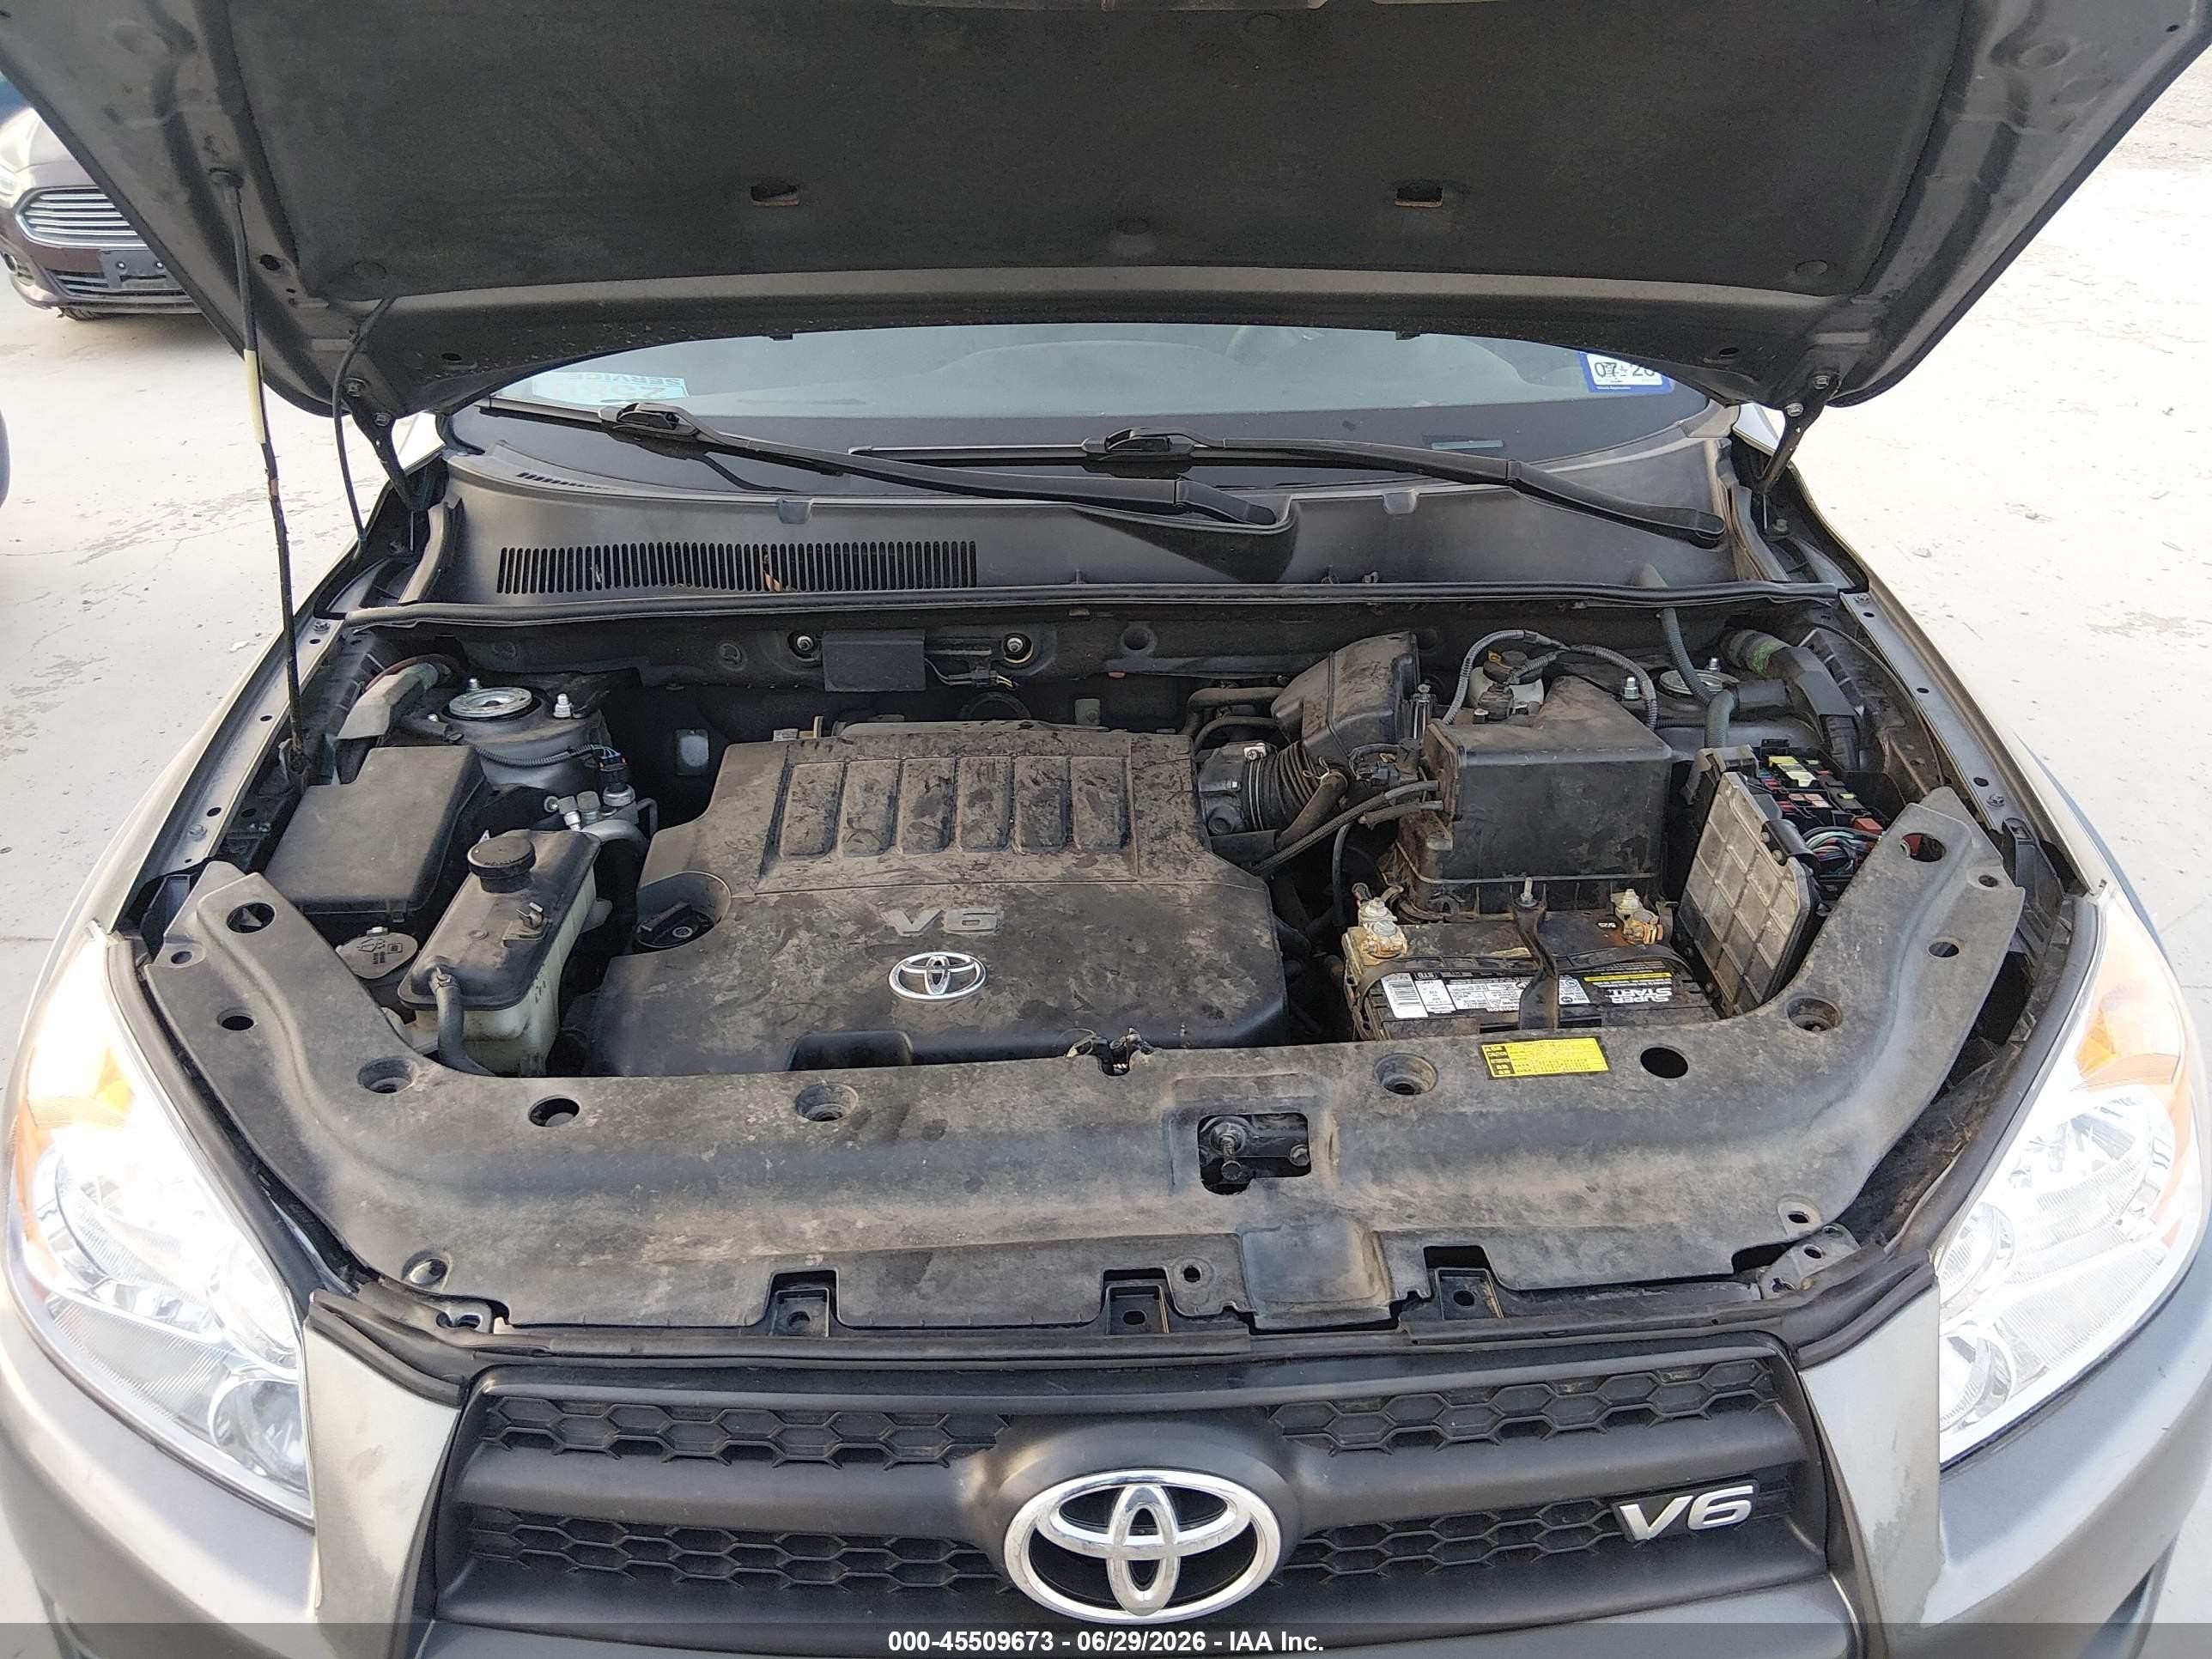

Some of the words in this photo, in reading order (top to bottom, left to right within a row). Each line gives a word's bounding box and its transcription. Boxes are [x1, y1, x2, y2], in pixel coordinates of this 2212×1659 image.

[569, 373, 681, 386] SERVICE
[882, 907, 1003, 936] V6
[1609, 988, 1673, 997] START
[1619, 1485, 1754, 1540] V6
